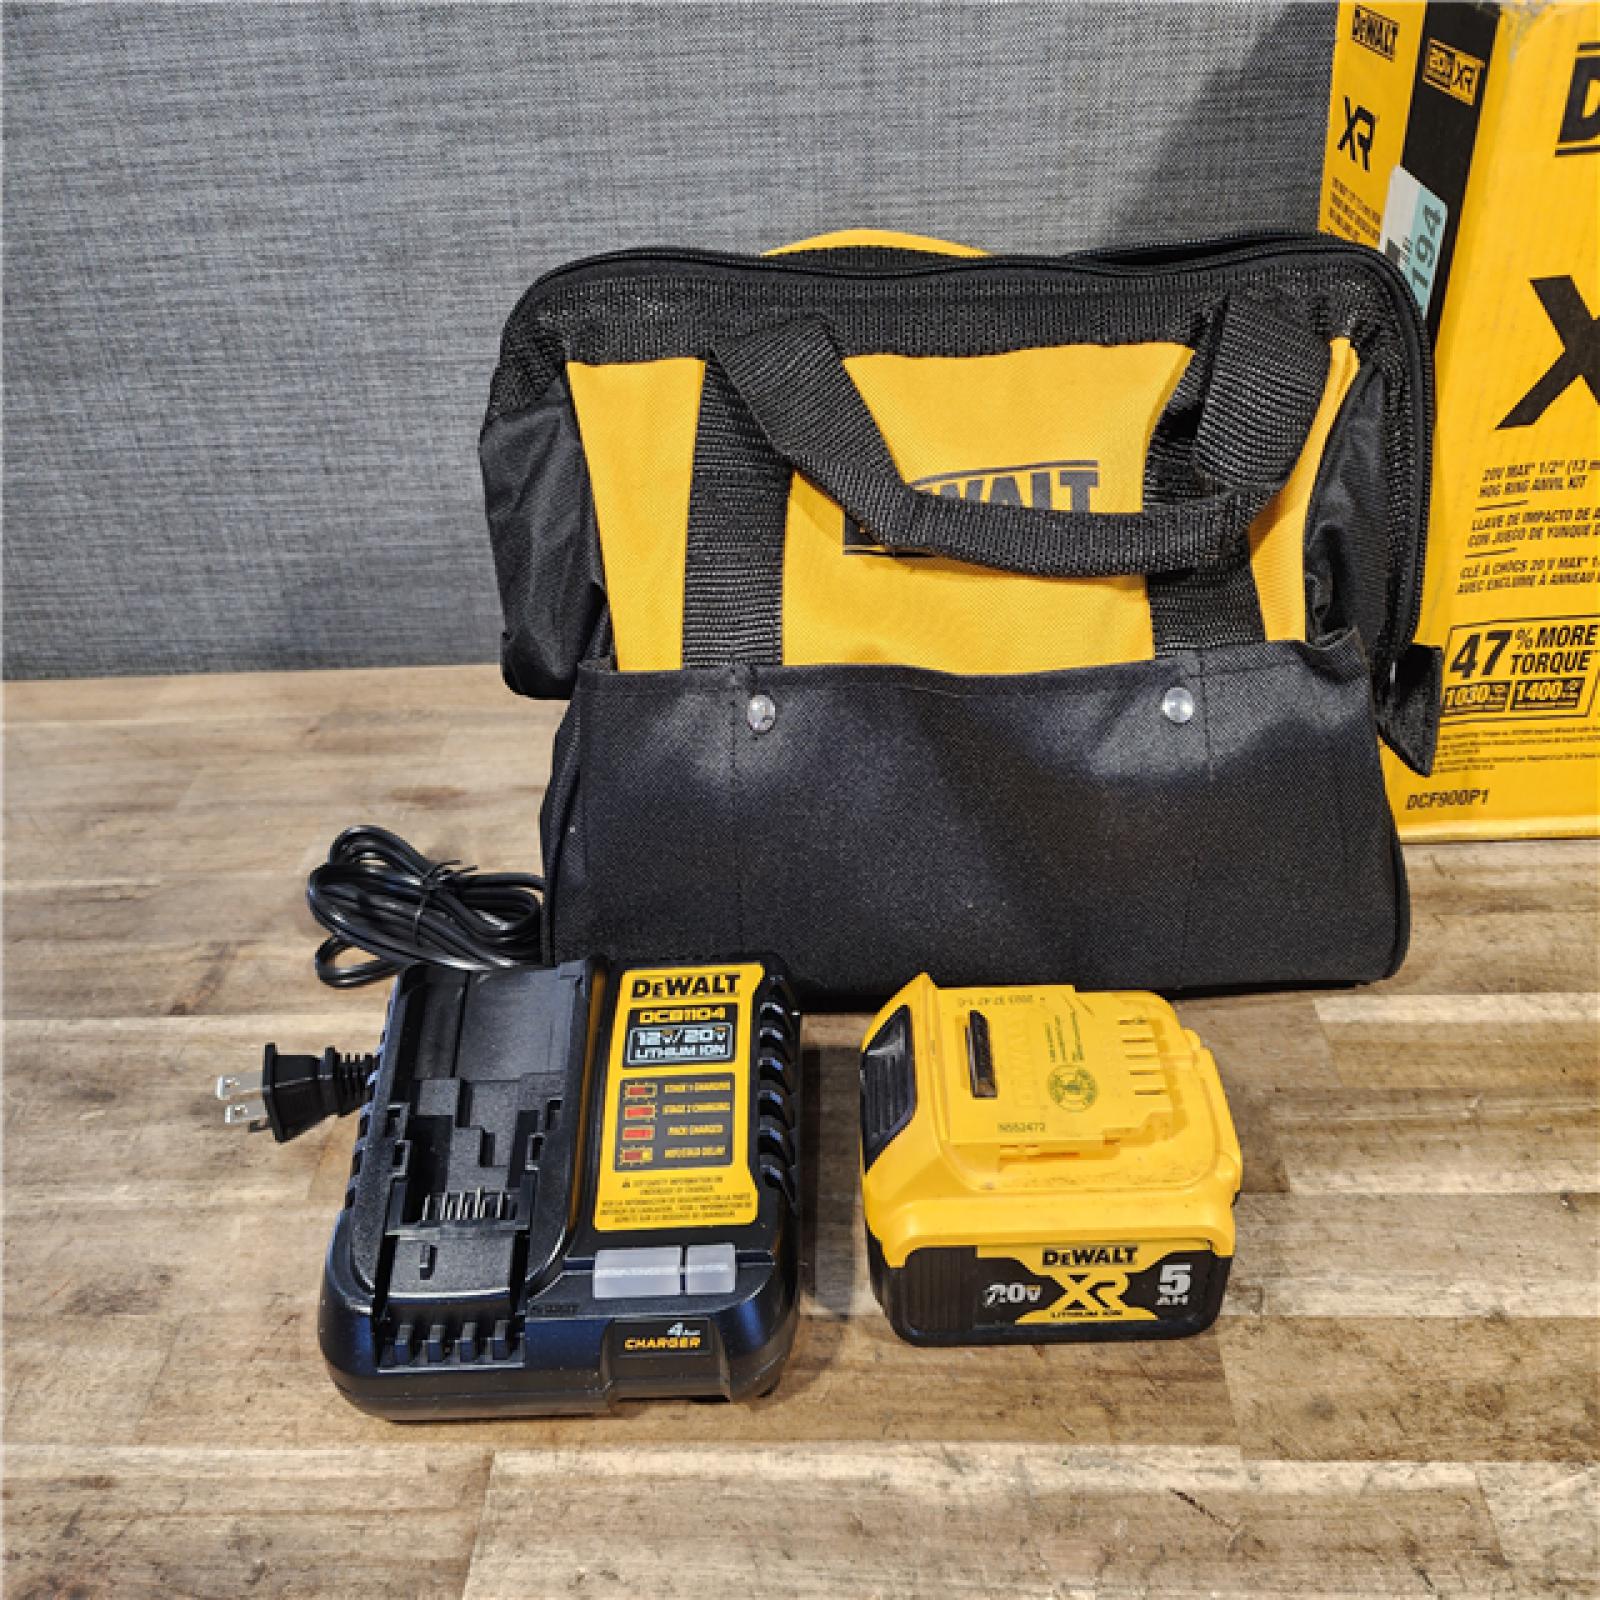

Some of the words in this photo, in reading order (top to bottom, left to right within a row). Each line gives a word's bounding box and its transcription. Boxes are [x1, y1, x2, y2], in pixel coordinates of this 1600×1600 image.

[1337, 96, 1376, 172] XR
[1449, 629, 1513, 679] 47
[1534, 624, 1599, 648] MORE
[1405, 788, 1490, 811] DCF900P1
[632, 974, 741, 999] DEWALT
[1042, 1246, 1138, 1267] DEWALT
[1157, 1263, 1193, 1297] 5
[666, 1321, 684, 1337] 4
[624, 1336, 701, 1351] CHARGER
